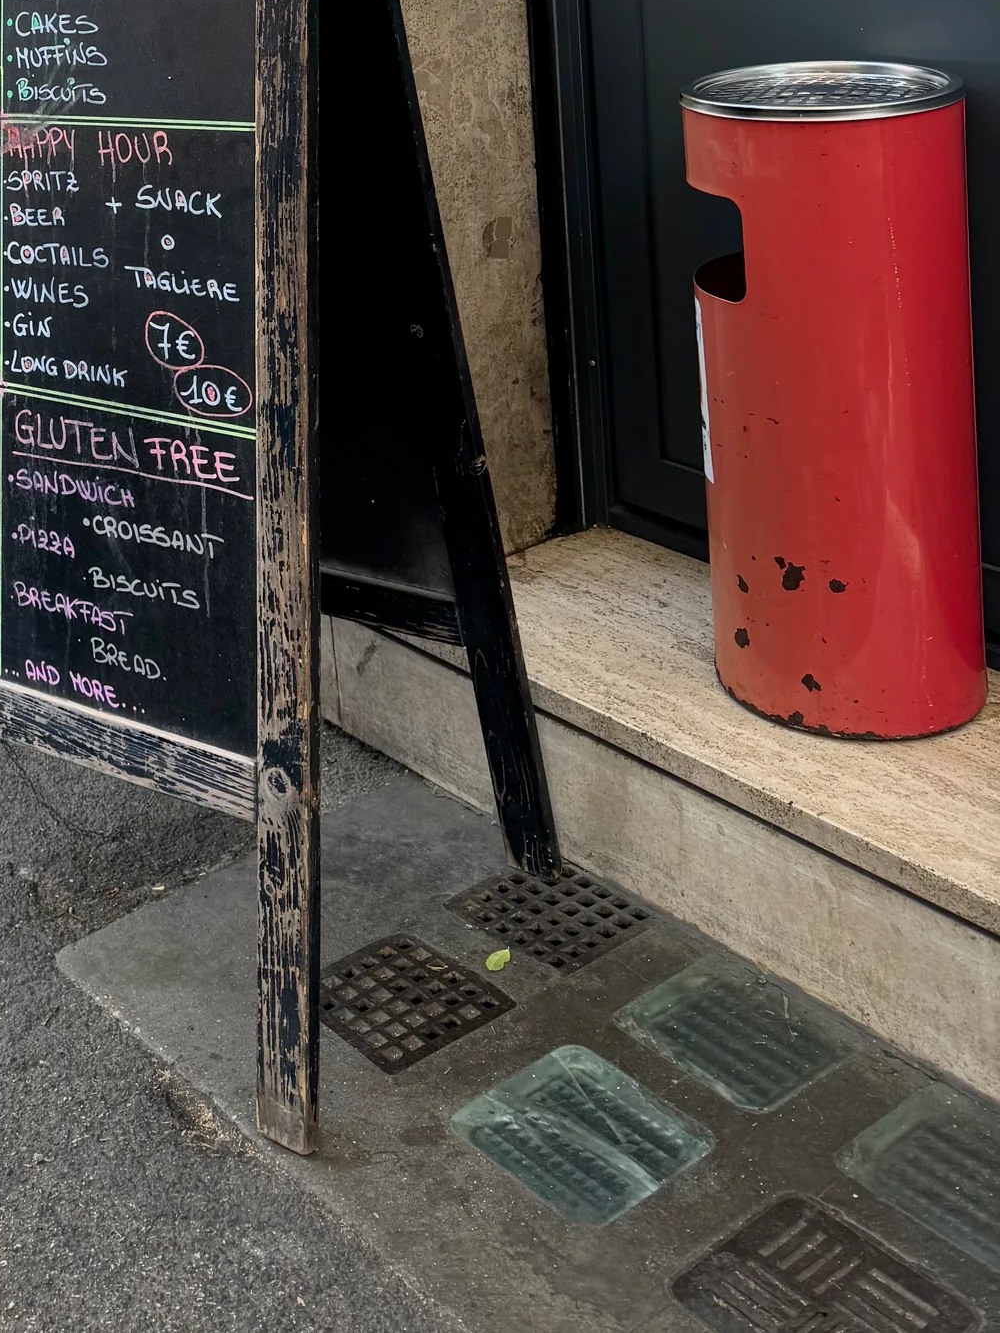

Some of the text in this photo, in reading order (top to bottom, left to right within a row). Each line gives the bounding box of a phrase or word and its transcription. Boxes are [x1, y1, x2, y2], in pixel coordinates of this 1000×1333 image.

[15, 11, 99, 37] CAKES
[15, 38, 108, 69] MUFFINS
[15, 77, 107, 104] BISCUITS
[6, 127, 173, 166] HAPPY HOUR
[6, 169, 80, 193] SPRITZ
[10, 203, 65, 226] BEER
[135, 184, 223, 218] SNACK
[7, 241, 110, 268] COCTAILS
[10, 276, 90, 308] WINES
[124, 265, 240, 303] TAGLIERE
[12, 312, 52, 338] GIN
[10, 349, 128, 388] LONG DRINK
[14, 409, 241, 482] GLUTEN FREE
[15, 467, 136, 508] SANDWICH
[17, 523, 76, 559] PIZZA
[92, 516, 225, 559] CROISSANT
[88, 567, 200, 609] BISCUITS
[14, 581, 134, 635] BREAKFAST
